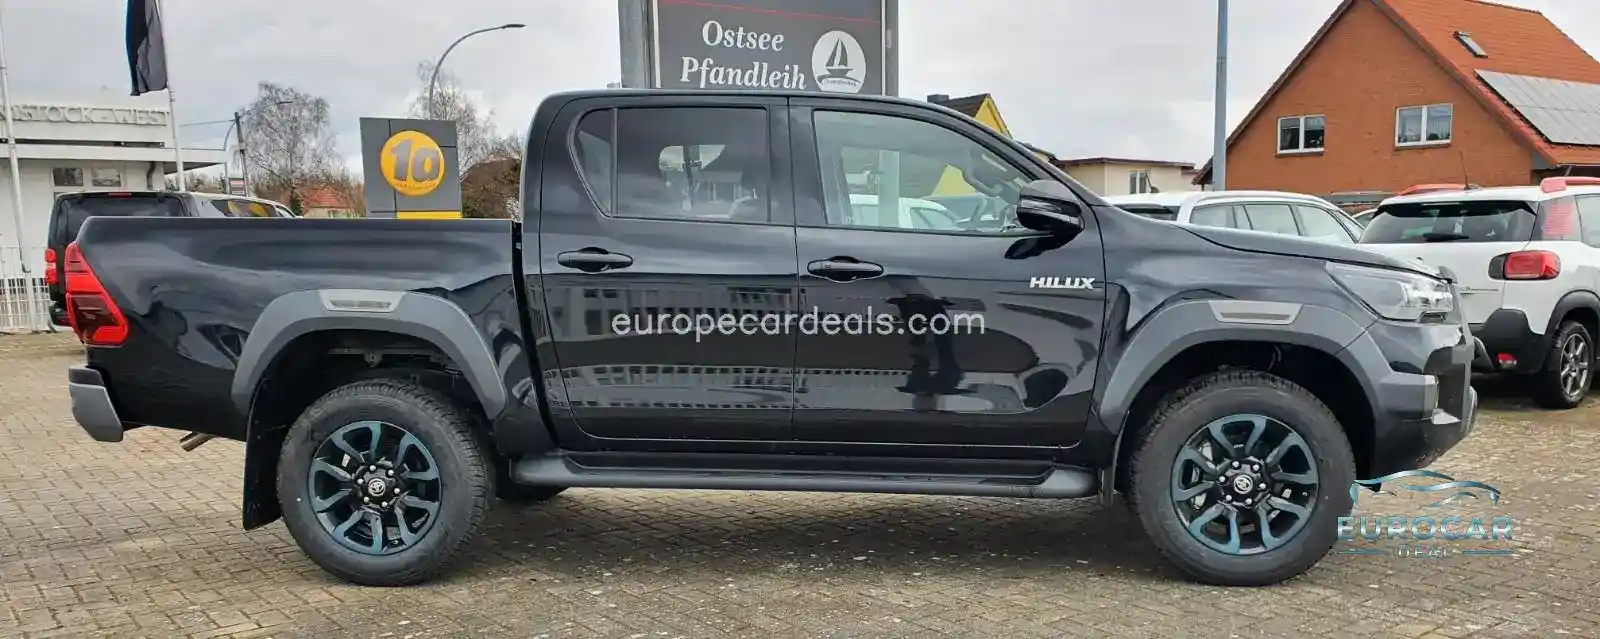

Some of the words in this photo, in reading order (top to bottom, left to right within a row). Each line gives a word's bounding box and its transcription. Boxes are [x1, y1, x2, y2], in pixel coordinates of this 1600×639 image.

[702, 20, 785, 51] Ostsee
[680, 56, 807, 90] Pfandleih
[112, 107, 169, 127] WEST
[1029, 276, 1096, 290] HILUX
